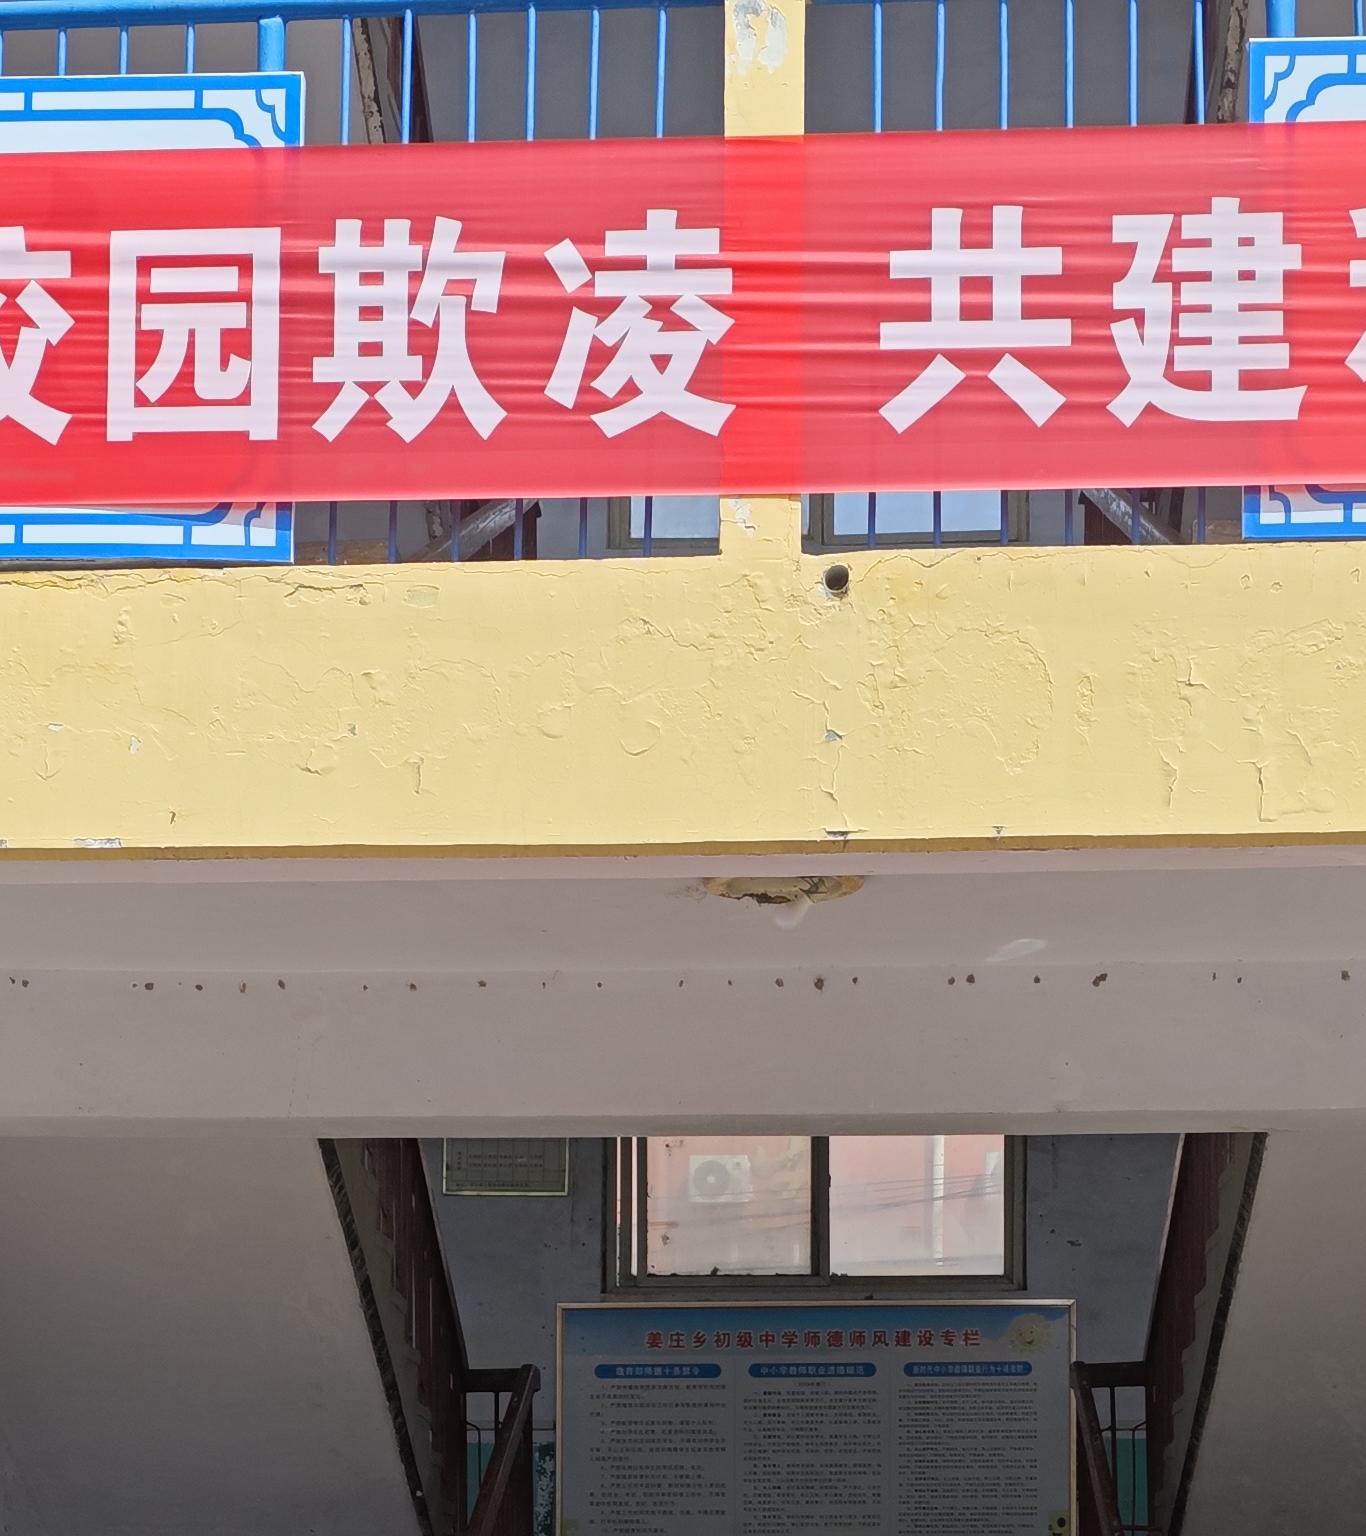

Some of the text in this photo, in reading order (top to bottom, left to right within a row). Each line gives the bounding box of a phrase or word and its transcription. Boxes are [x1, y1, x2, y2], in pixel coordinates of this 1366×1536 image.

[645, 1329, 981, 1349] 姜庄乡初级中学师德师风建设专栏
